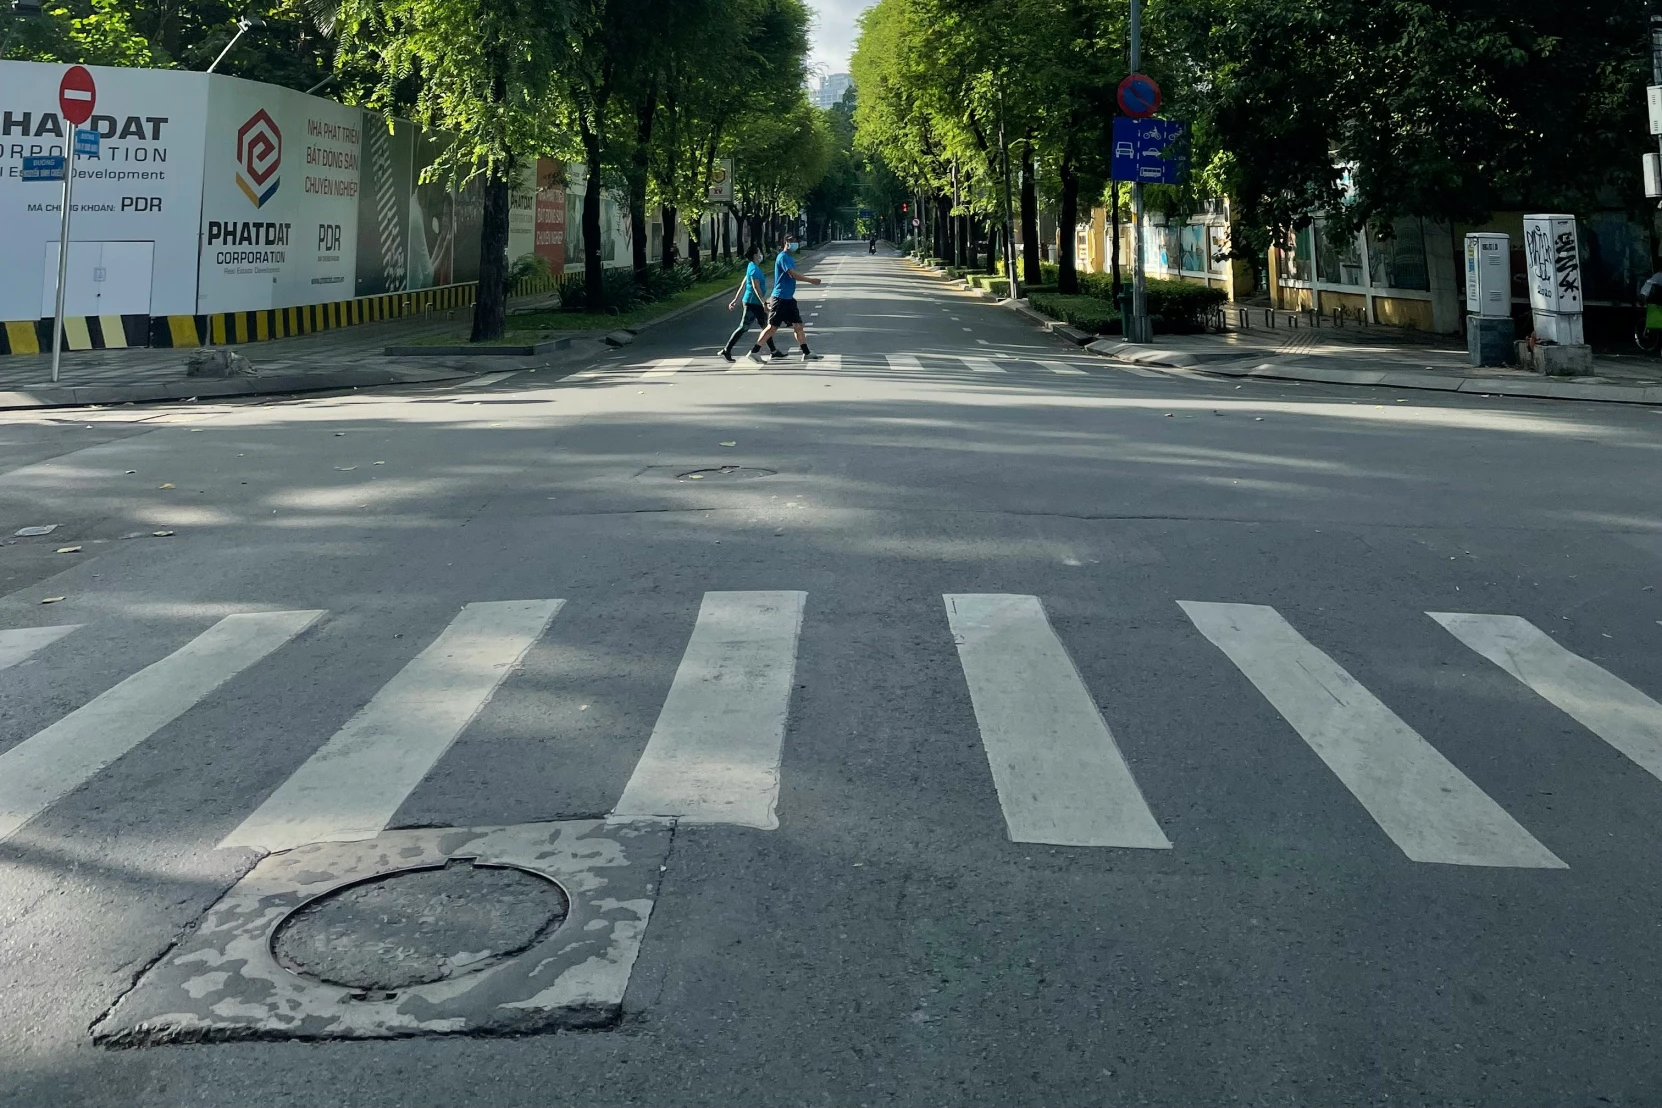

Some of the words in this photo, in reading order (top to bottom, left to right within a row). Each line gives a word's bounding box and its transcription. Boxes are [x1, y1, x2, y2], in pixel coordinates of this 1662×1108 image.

[2, 111, 168, 141] HADAT
[323, 122, 342, 142] PHÁT
[322, 147, 343, 171] ĐỘNG
[304, 175, 333, 196] CHUYÊN
[333, 178, 358, 200] NGHIỆP
[45, 203, 79, 212] CHG
[121, 196, 162, 212] PDR
[207, 221, 291, 246] PHATDAT
[318, 224, 341, 251] PDR
[216, 251, 285, 265] CORPORATION
